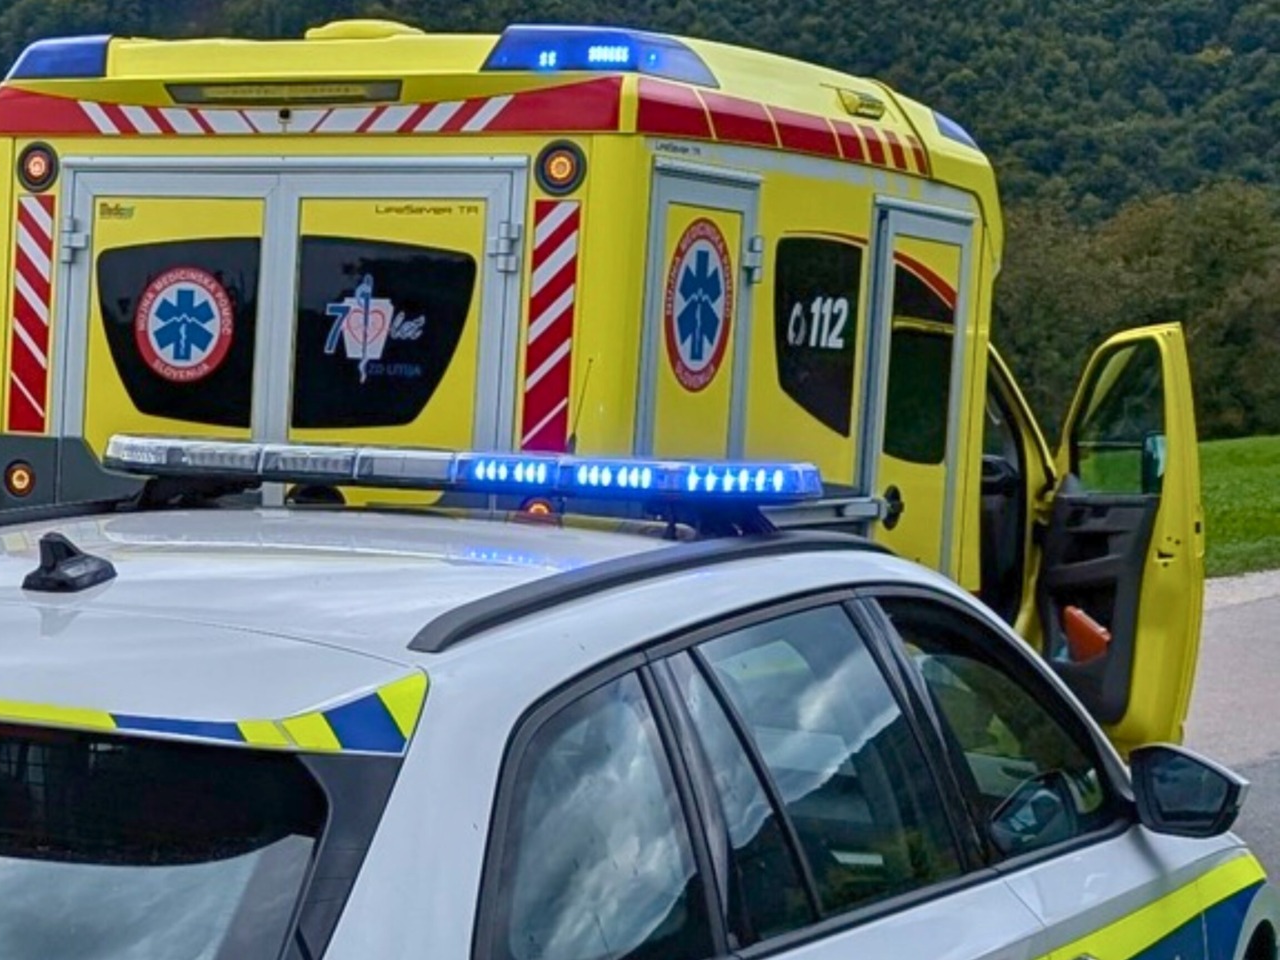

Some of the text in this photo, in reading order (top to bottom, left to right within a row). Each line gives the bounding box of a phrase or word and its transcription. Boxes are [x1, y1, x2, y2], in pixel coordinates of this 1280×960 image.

[137, 291, 156, 332] NUJNA
[154, 268, 219, 293] MEDICINSKA
[809, 296, 849, 349] 112
